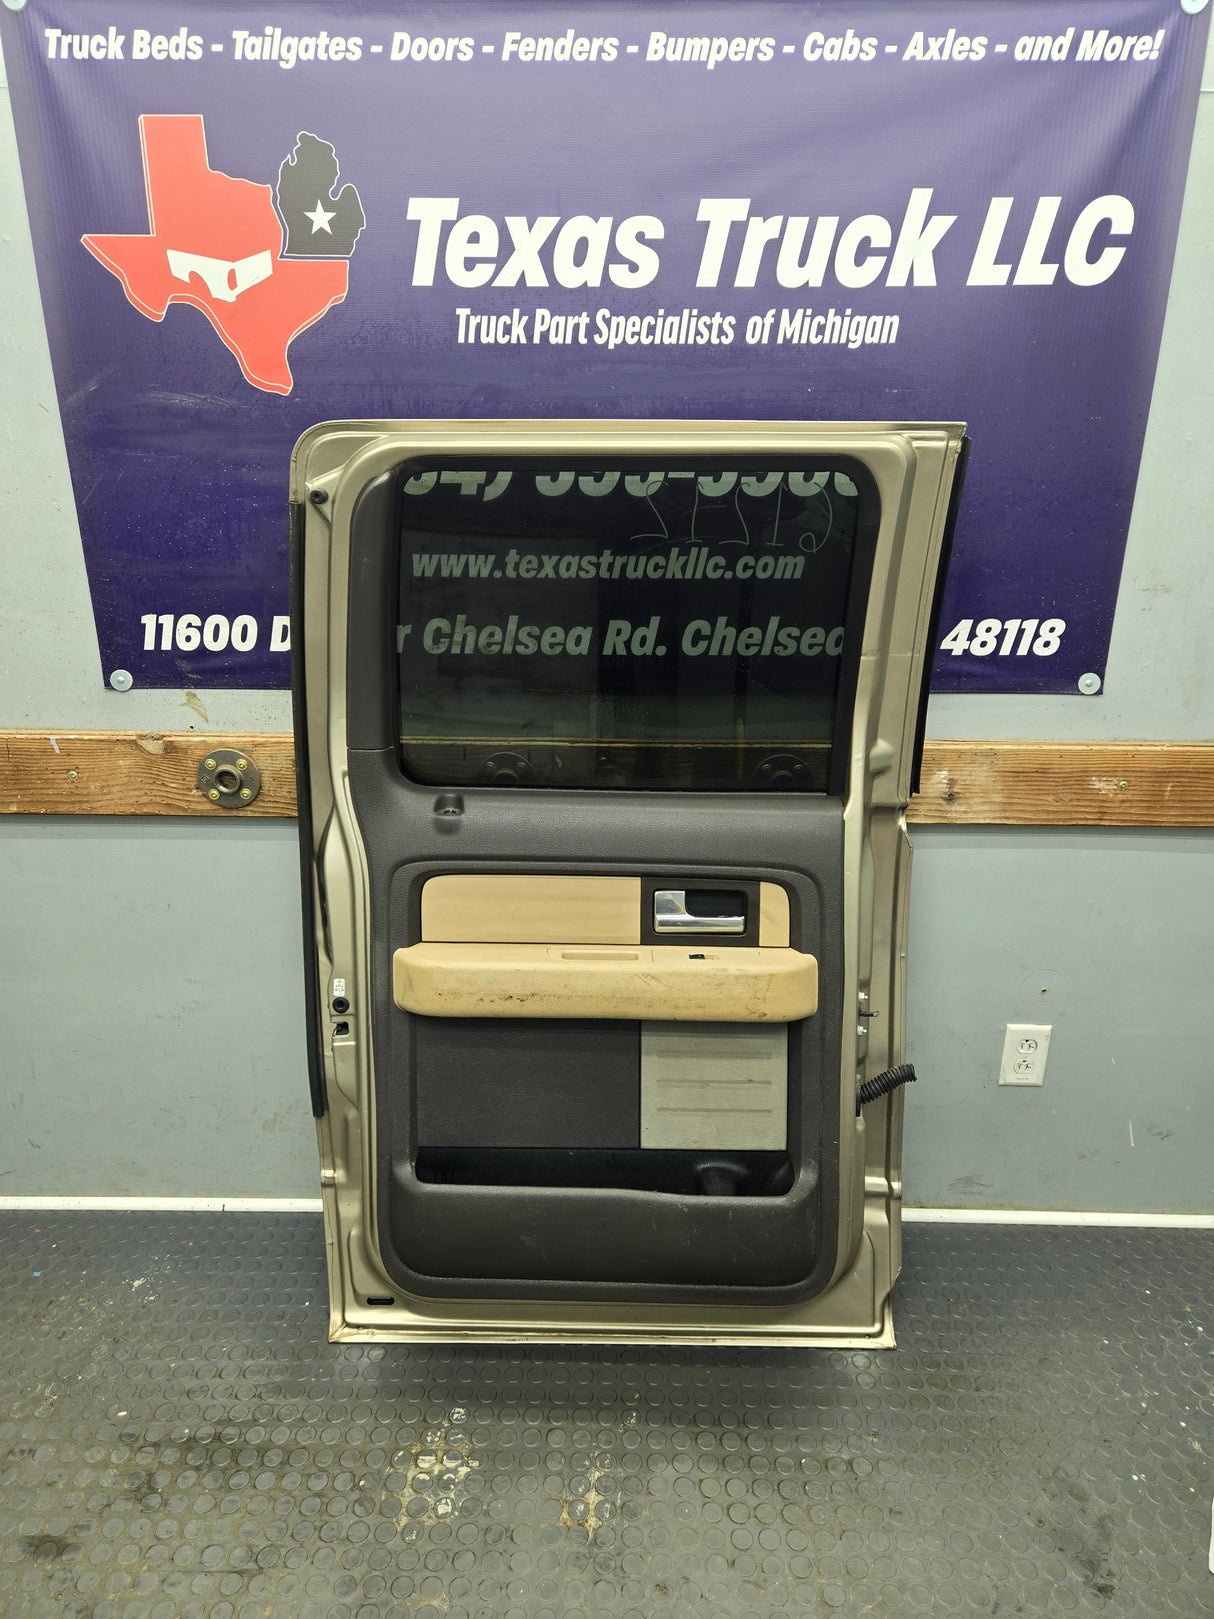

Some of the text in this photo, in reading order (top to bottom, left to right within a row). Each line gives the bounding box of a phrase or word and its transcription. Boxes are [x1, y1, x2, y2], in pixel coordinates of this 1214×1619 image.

[44, 28, 125, 61] Truck
[132, 28, 204, 62] Beds
[232, 27, 364, 70] Tailgates
[390, 32, 476, 63] Doors
[501, 30, 620, 63] Fenders
[645, 32, 776, 70] Bumpers
[803, 29, 879, 63] Cabs
[902, 29, 990, 62] Axles
[1014, 29, 1075, 62] and
[1075, 29, 1167, 62] More!
[406, 188, 1136, 289] Texas Truck LLC
[455, 308, 901, 351] Truck Part Specialists of Michigan
[411, 546, 806, 581] www.texastruckllc.com
[140, 614, 259, 652] 11600
[422, 614, 595, 656] Chelsea
[602, 616, 669, 657] Rd.
[939, 618, 1068, 657] 48118
